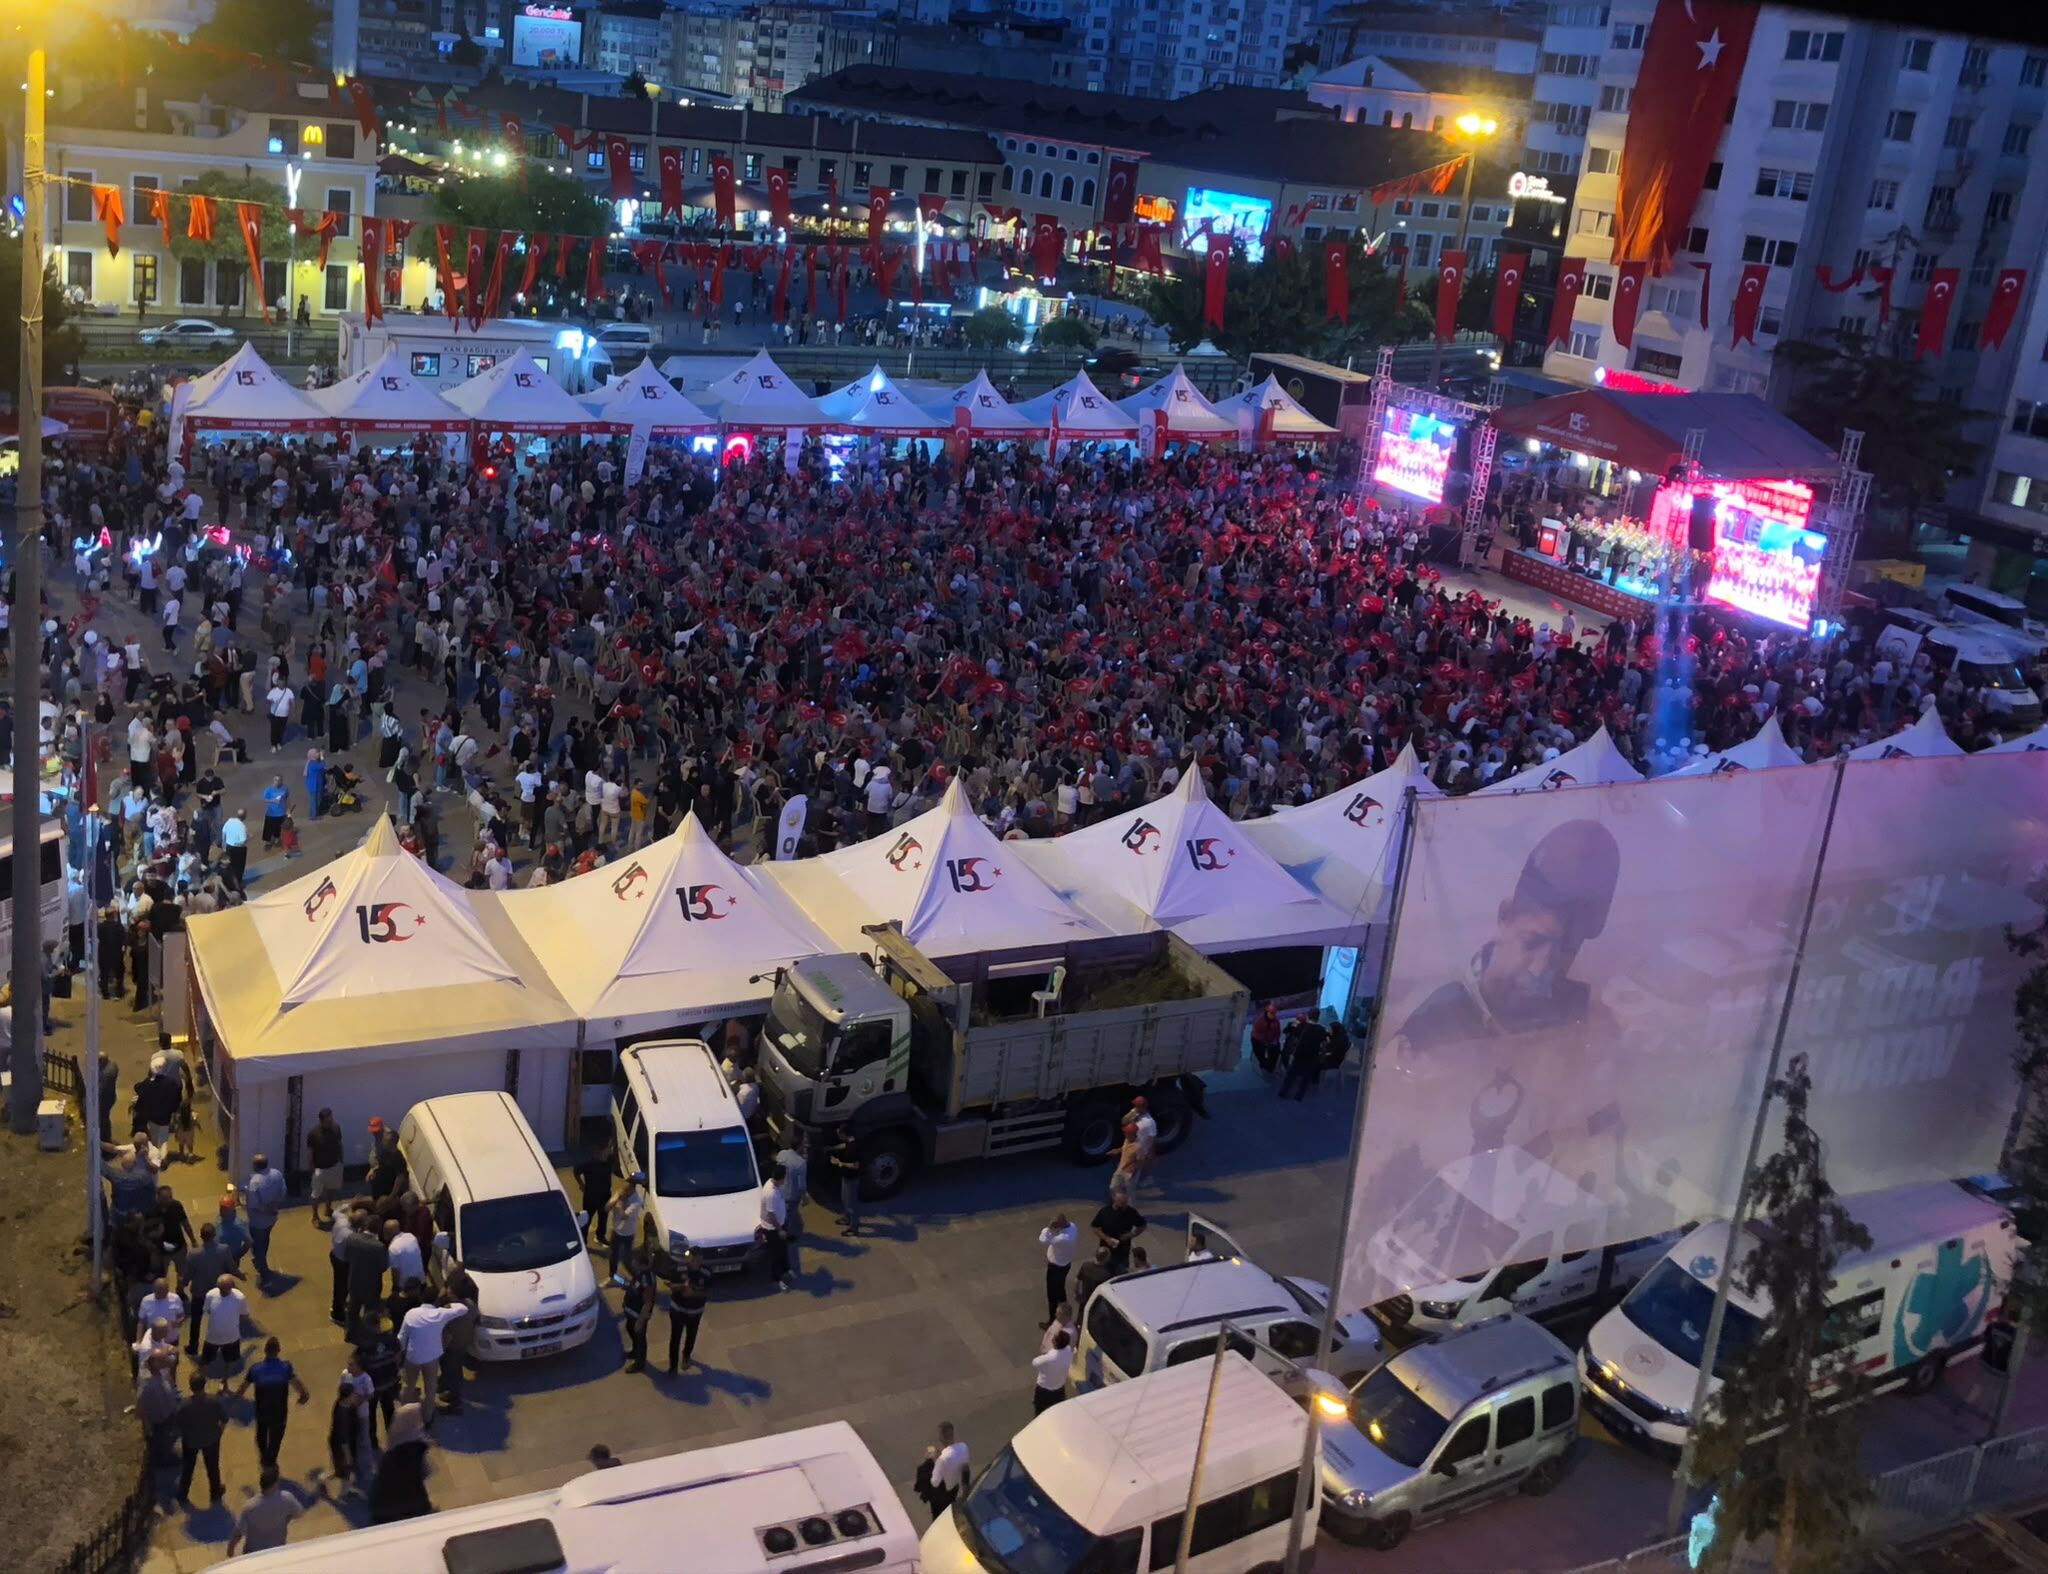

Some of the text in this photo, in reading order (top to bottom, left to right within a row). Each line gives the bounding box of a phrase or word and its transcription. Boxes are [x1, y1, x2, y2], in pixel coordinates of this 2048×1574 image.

[236, 371, 255, 386] 15
[381, 376, 400, 392] 15
[515, 373, 532, 388] 15
[758, 375, 775, 389] 15
[641, 386, 660, 400] 15
[875, 391, 891, 405] 15
[979, 394, 996, 408] 15
[1081, 396, 1098, 409] 15
[1176, 389, 1192, 402] 15
[1344, 793, 1380, 827] 15
[1122, 817, 1158, 855] 15
[886, 832, 922, 871] 15
[1186, 838, 1222, 871] 15
[612, 861, 648, 900] 15
[946, 857, 986, 893] 15
[304, 875, 337, 922] 15
[676, 884, 718, 922] 15
[356, 902, 402, 944] 15
